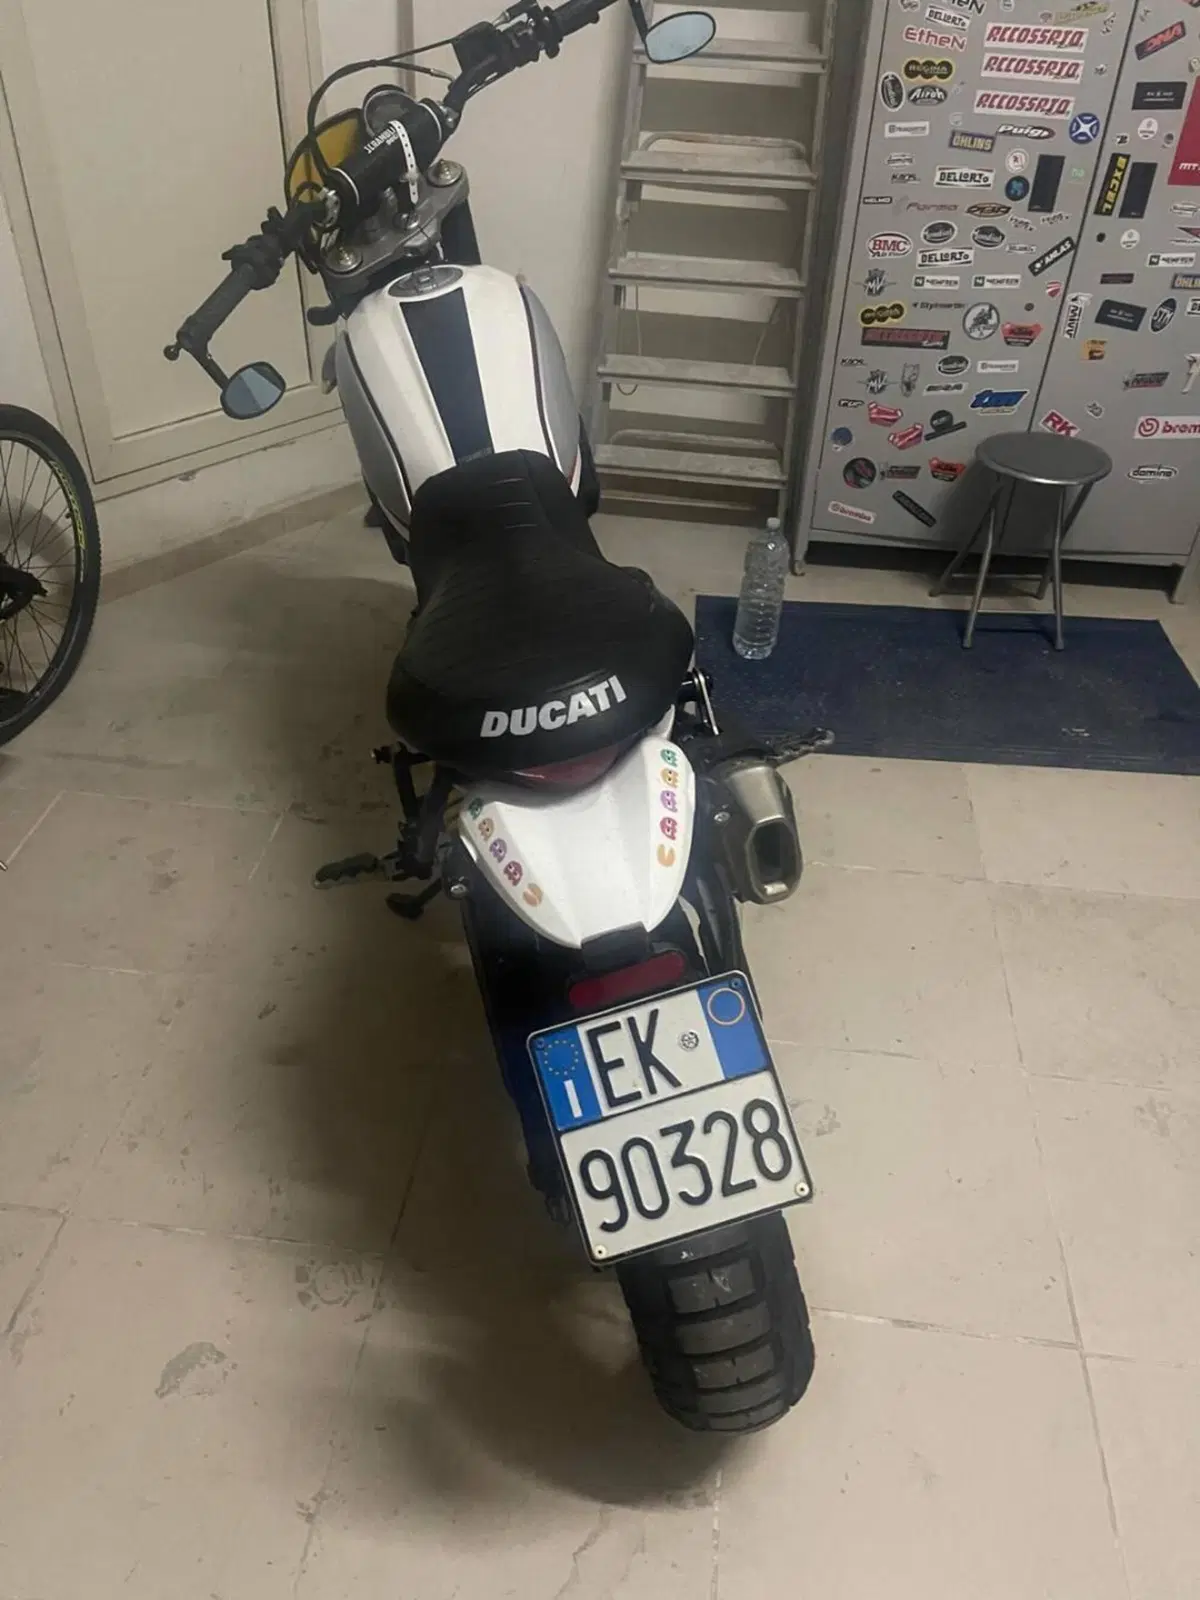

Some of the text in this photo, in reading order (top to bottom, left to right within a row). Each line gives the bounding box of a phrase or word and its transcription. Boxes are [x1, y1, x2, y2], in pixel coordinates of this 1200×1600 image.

[904, 27, 966, 49] EtheN
[939, 172, 989, 183] DELLORTO
[872, 239, 908, 252] BMC
[921, 251, 969, 263] DELLORTO
[1041, 411, 1078, 437] RK
[480, 675, 627, 738] DUCATI
[586, 1008, 682, 1108] EK
[579, 1098, 793, 1233] 90328
